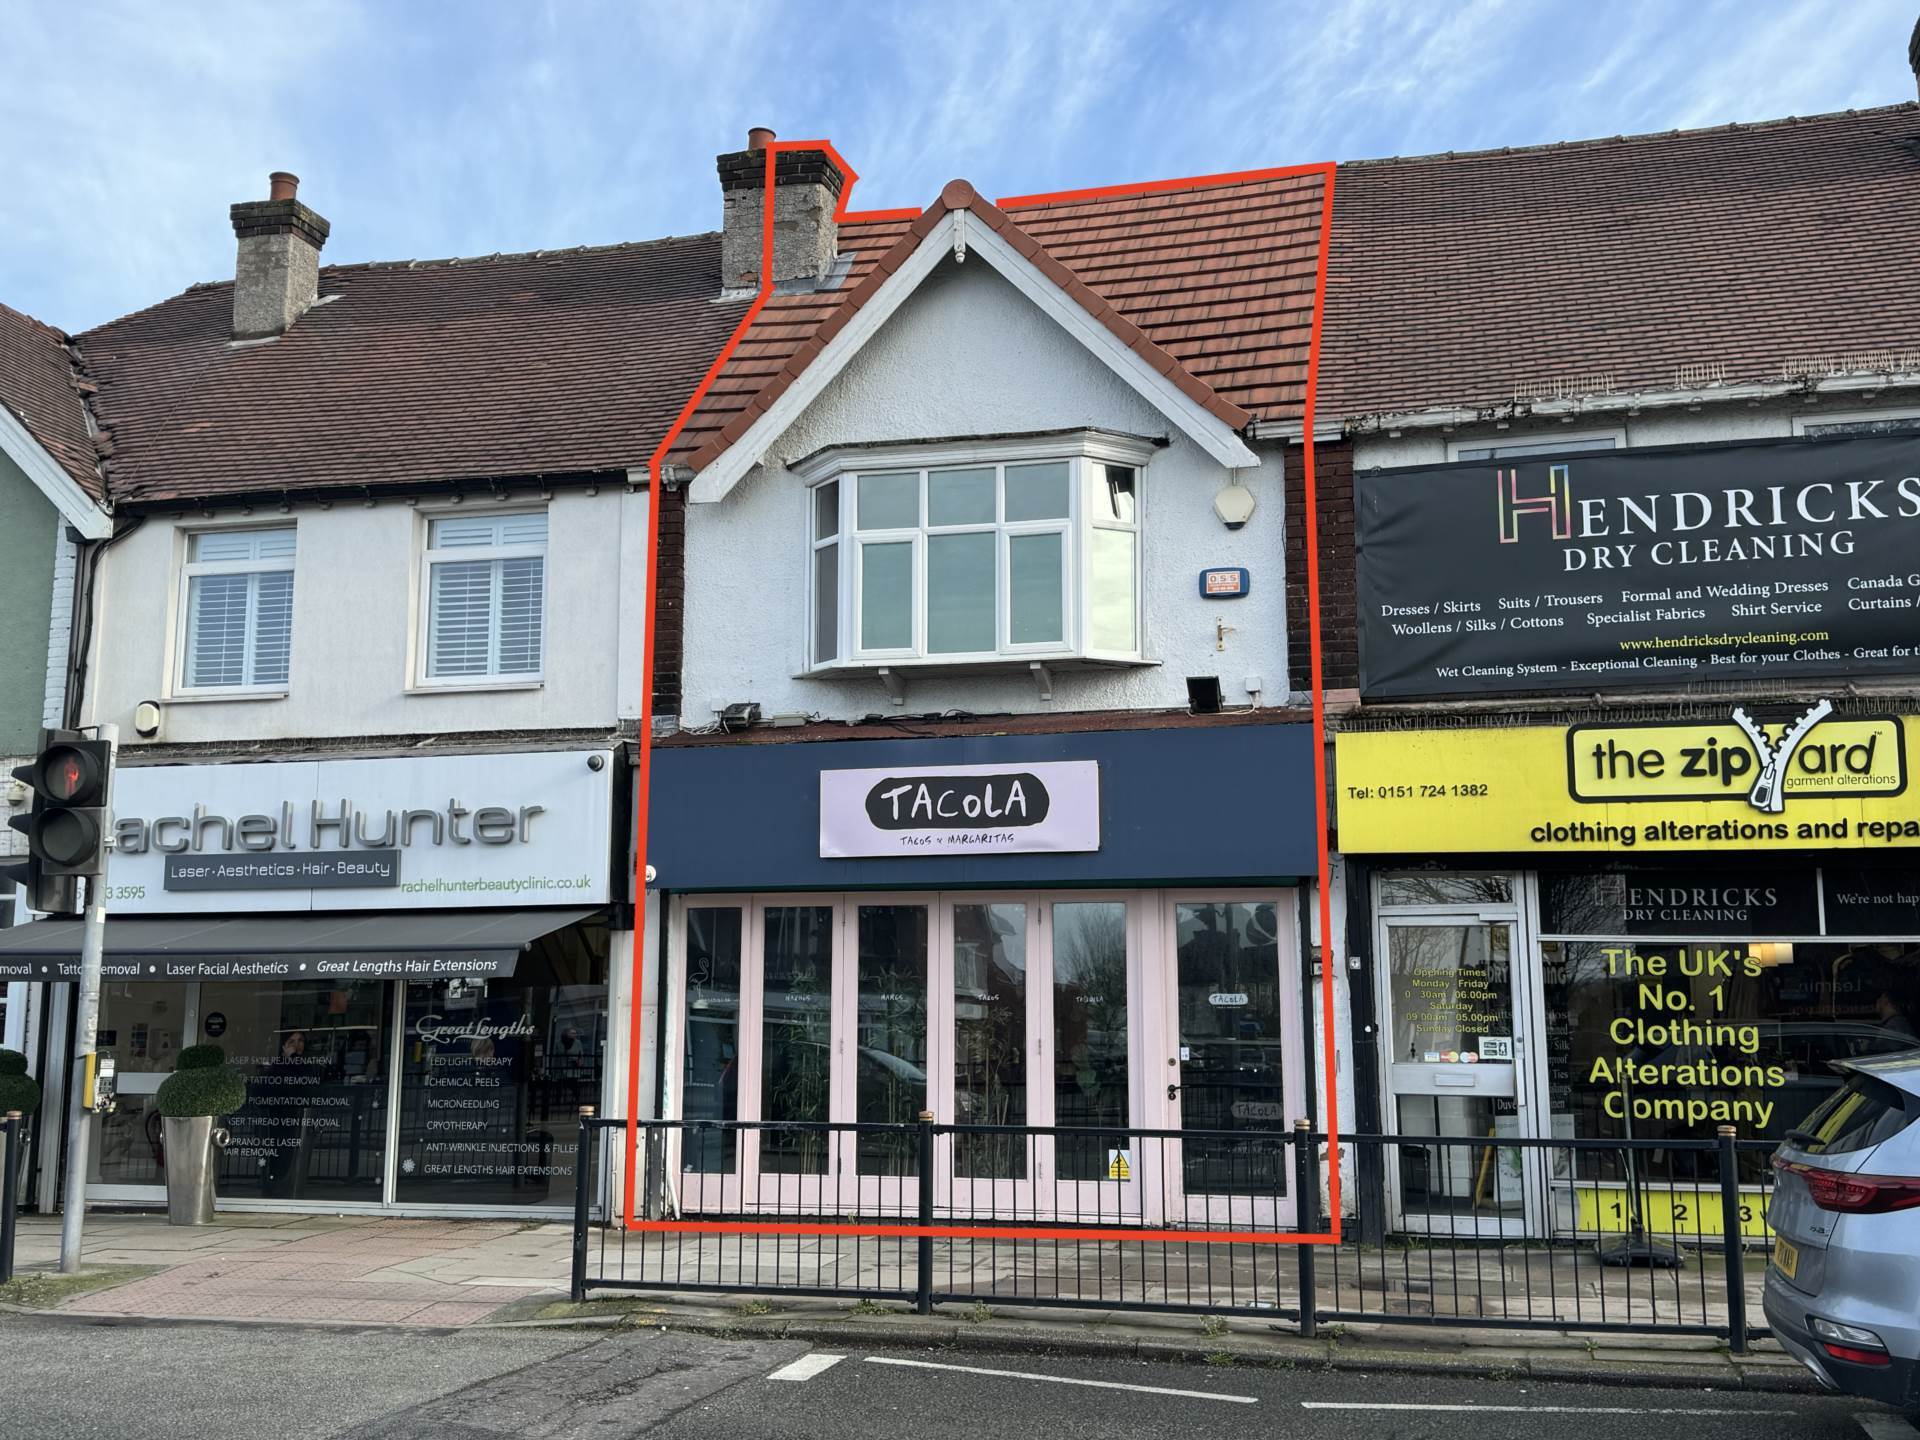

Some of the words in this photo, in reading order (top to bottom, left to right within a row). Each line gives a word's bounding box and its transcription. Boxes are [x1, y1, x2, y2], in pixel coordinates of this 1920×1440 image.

[1497, 464, 1920, 544] HENDRICKS
[1563, 544, 1637, 571] DRY
[1651, 531, 1856, 566] CLEANING
[1847, 575, 1903, 590] Canada
[1621, 589, 1671, 602] Formal
[1675, 586, 1702, 599] and
[1706, 583, 1771, 599] Wedding
[1774, 580, 1829, 594] Dresses
[1381, 603, 1430, 617] Dresses
[1443, 600, 1481, 614] Skirts
[1498, 596, 1531, 610] Suits
[1544, 593, 1603, 607] Trousers
[1731, 603, 1767, 617] Shirt
[1770, 601, 1823, 615] Service
[1848, 596, 1911, 610] Curtains
[1392, 621, 1452, 635] Woollens
[1465, 618, 1497, 632] Silks
[1510, 615, 1564, 629] Cottons
[1586, 609, 1651, 628] Specialist
[1655, 607, 1706, 621] Fabrics
[1620, 630, 1829, 650] www.hendricksdrycleaning.com
[1436, 666, 1458, 677] Wet
[1462, 664, 1513, 678] Cleaning
[1517, 661, 1557, 675] System
[1570, 658, 1639, 673] Exceptional
[1643, 656, 1698, 669] Cleaning
[1710, 653, 1736, 665] Best
[1740, 651, 1758, 663] for
[1761, 652, 1790, 667] your
[1793, 649, 1840, 661] Clothes
[1853, 647, 1888, 659] Great
[1892, 645, 1911, 657] for
[1592, 738, 1665, 779] the
[1786, 775, 1834, 789] garment
[1837, 772, 1896, 786] alterations
[1348, 786, 1374, 799] Tel:
[1378, 786, 1413, 799] 0151
[1420, 785, 1446, 798] 724
[1451, 784, 1488, 797] 1382
[881, 780, 1026, 820] TACOLA
[115, 800, 296, 854] achel
[310, 798, 547, 849] Hunter
[1530, 821, 1636, 846] clothing
[1644, 819, 1789, 842] alterations
[1797, 818, 1848, 840] and
[900, 836, 931, 846] TACOS
[947, 833, 1015, 845] MARGARITAS
[171, 866, 210, 878] Laser
[217, 863, 295, 877] Aesthetics
[302, 862, 330, 875] Hair
[337, 861, 390, 877] Beauty
[401, 874, 592, 893] rachelhunterbeautyclinic.co.uk
[116, 886, 145, 899] 3595
[1836, 893, 1870, 904] We're
[1874, 893, 1893, 904] not
[1623, 909, 1655, 921] DRY
[1660, 908, 1748, 921] CLEANING
[100, 962, 140, 975] emoval
[166, 963, 196, 975] Laser
[198, 962, 229, 975] Facial
[232, 961, 289, 974] Aesthetics
[317, 960, 350, 973] Great
[353, 960, 402, 975] Lengths
[405, 959, 430, 972] Hair
[433, 959, 498, 972] Extensions
[1600, 948, 1667, 976] The
[1678, 948, 1762, 977] UK's
[1413, 968, 1454, 978] Opening
[1458, 968, 1487, 976] Times
[1412, 979, 1450, 989] Monday
[1458, 979, 1489, 989] Friday
[1454, 991, 1498, 1000] 06.00pm
[1639, 983, 1695, 1011] No.
[1708, 984, 1724, 1012] 1
[1430, 1002, 1473, 1012] Saturday
[1416, 1024, 1452, 1034] Sunday
[1455, 1024, 1489, 1033] Closed
[1609, 1017, 1760, 1054] Clothing
[225, 1056, 249, 1065] LASER
[271, 1056, 332, 1065] REJUVENATION
[430, 1057, 446, 1066] LED
[448, 1057, 472, 1066] LIGHT
[475, 1057, 513, 1067] THERAPY
[1589, 1056, 1786, 1087] Alterations
[250, 1076, 282, 1085] TATTOO
[429, 1078, 473, 1087] CHEMICAL
[475, 1078, 500, 1087] PEELS
[248, 1097, 310, 1106] PIGMENTATION
[311, 1097, 350, 1106] REMOVAL
[427, 1099, 500, 1109] MICRONEEDLING
[1603, 1091, 1774, 1129] Company
[248, 1117, 280, 1127] THREAD
[281, 1117, 300, 1127] VEIN
[301, 1118, 341, 1127] REMOVAL
[426, 1121, 488, 1130] CRYOTHERAPY
[228, 1137, 260, 1147] OPRANO
[261, 1137, 275, 1147] ICE
[276, 1138, 302, 1147] LASER
[426, 1143, 486, 1153] ANTI-WRINKLE
[488, 1143, 540, 1153] INJECTIONS
[543, 1144, 551, 1153] &
[240, 1148, 279, 1157] REMOVAL
[424, 1165, 452, 1174] GREAT
[453, 1165, 494, 1175] LENGTHS
[495, 1165, 515, 1175] HAIR
[517, 1166, 573, 1176] EXTENSIONS
[1611, 1203, 1621, 1219] 1
[1673, 1204, 1688, 1221] 2
[1739, 1205, 1753, 1222] 3
